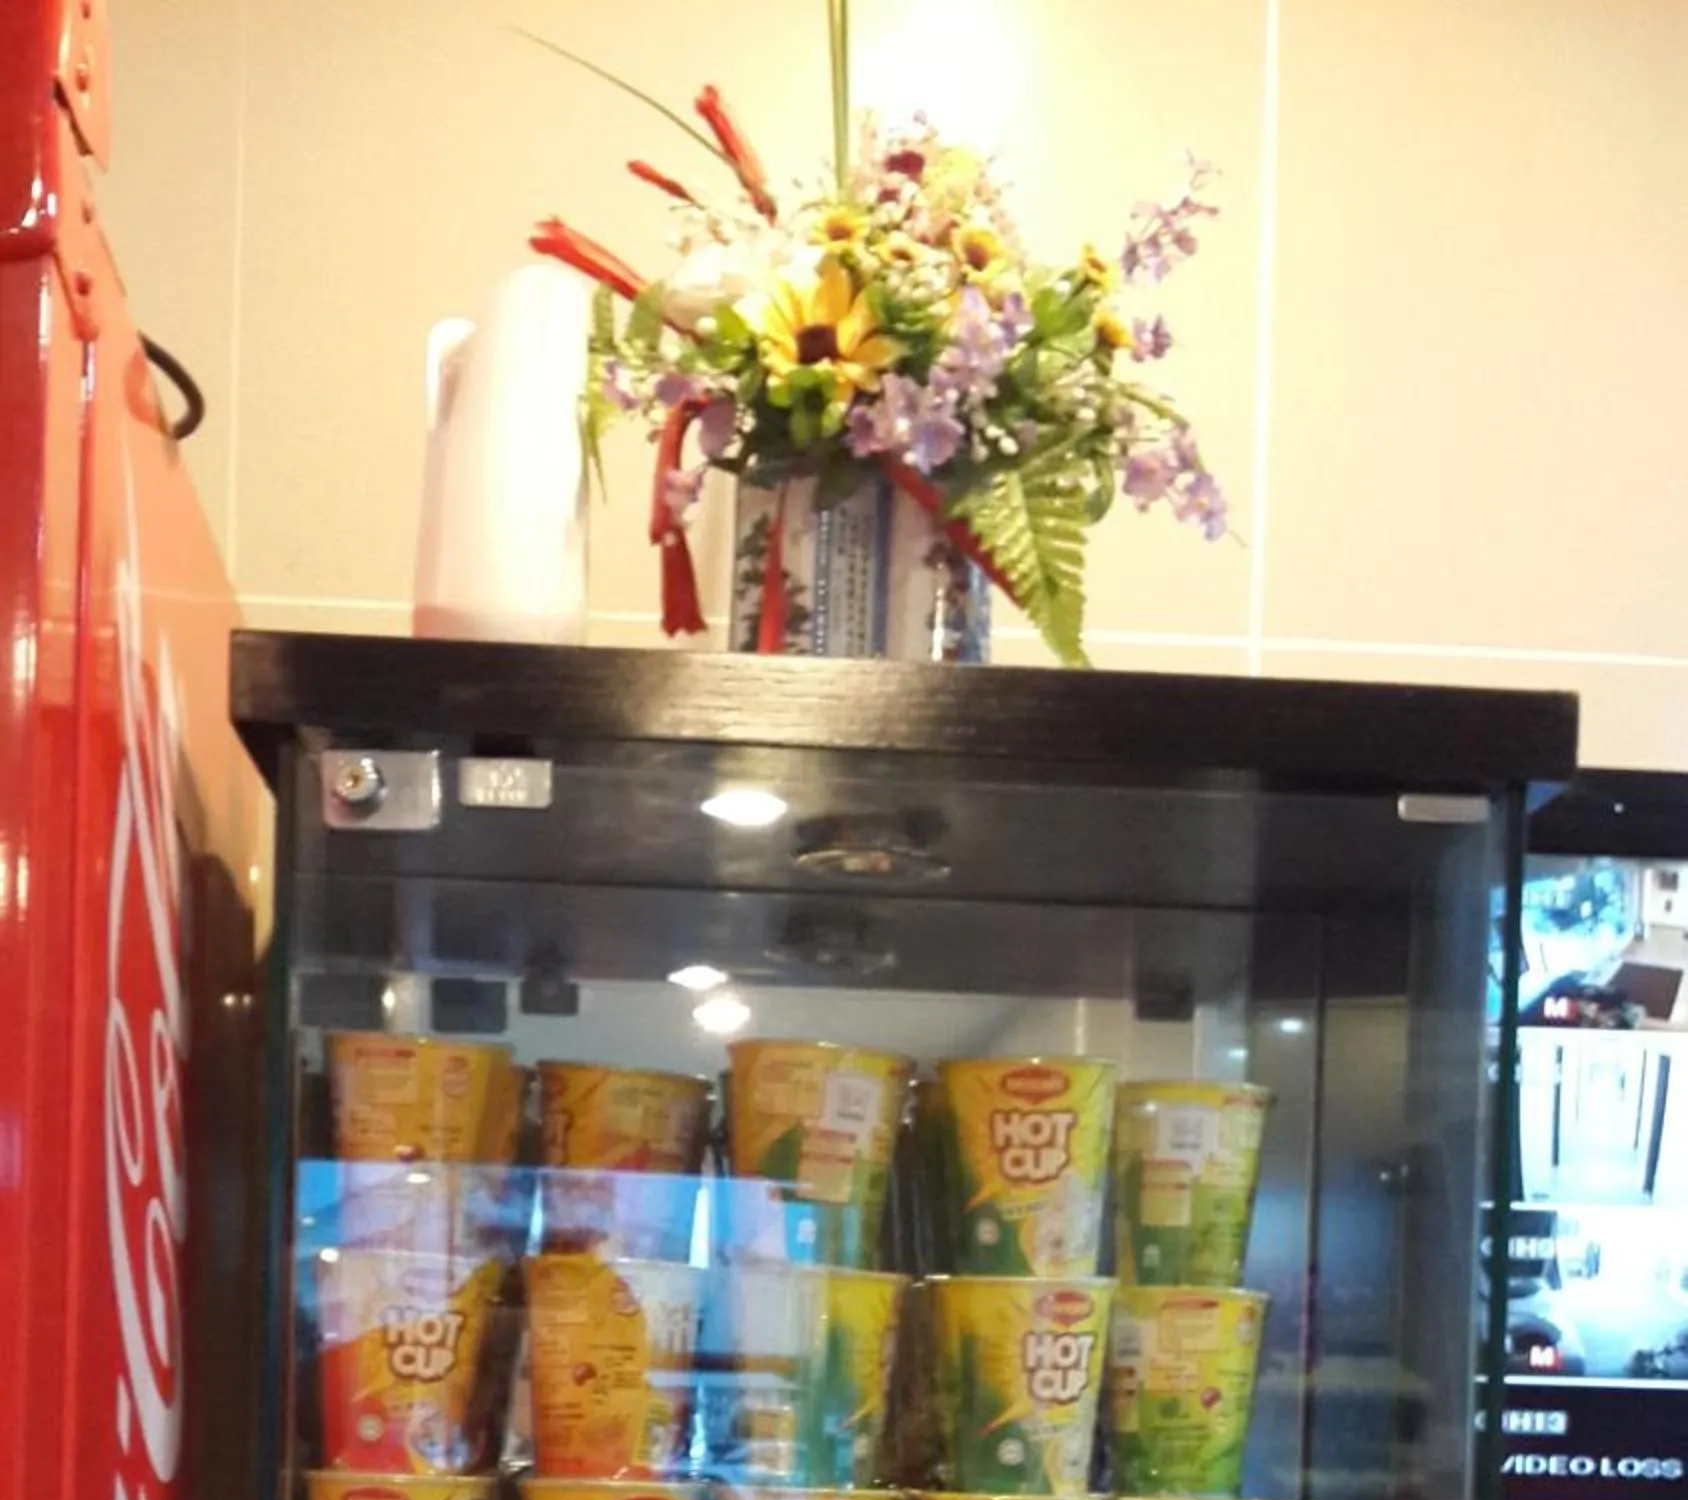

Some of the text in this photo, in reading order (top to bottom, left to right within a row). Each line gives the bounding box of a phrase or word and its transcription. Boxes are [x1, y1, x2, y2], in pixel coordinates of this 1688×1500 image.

[990, 1109, 1077, 1150] HOT
[1000, 1146, 1070, 1183] CUP
[383, 1307, 466, 1350] HOT
[389, 1345, 456, 1382] CUP
[1024, 1331, 1097, 1371] HOT
[1029, 1368, 1090, 1403] CUP
[1600, 1455, 1683, 1478] LOSS
